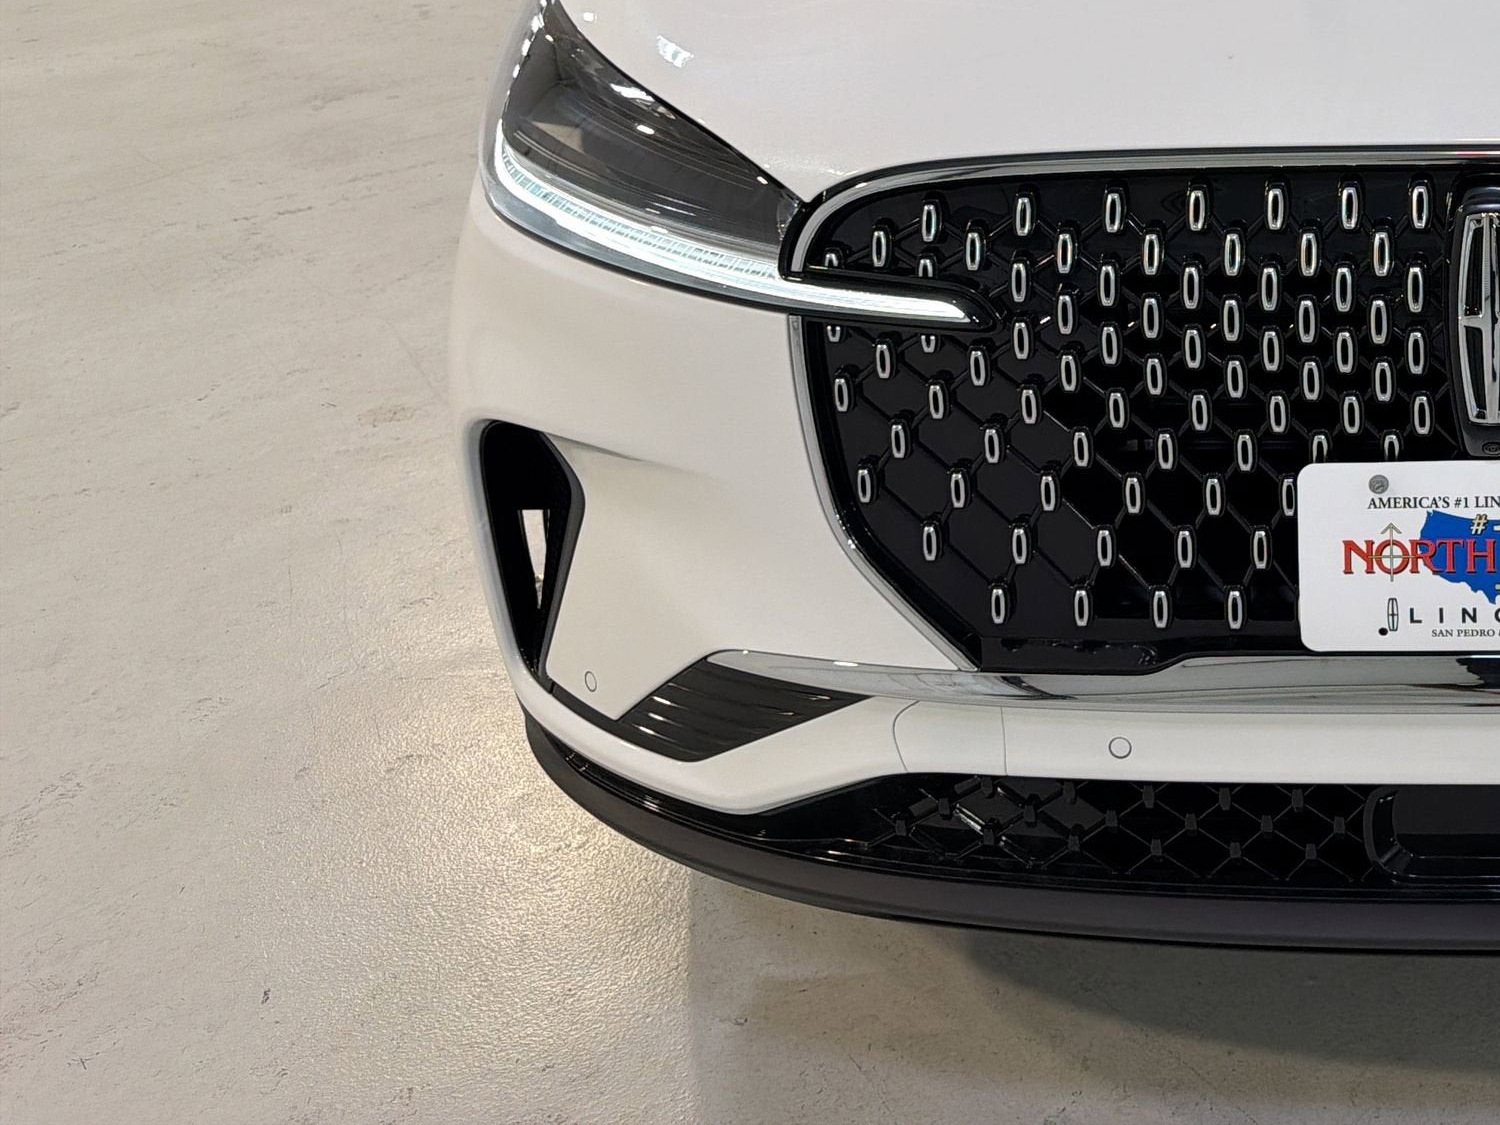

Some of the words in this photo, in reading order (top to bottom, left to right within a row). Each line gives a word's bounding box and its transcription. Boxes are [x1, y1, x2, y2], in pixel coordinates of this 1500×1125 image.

[1368, 496, 1450, 509] AMERICA'S
[1454, 496, 1469, 509] #1
[1342, 538, 1496, 575] NORTH
[1431, 628, 1454, 638] SAN
[1457, 628, 1496, 637] PEDRO
